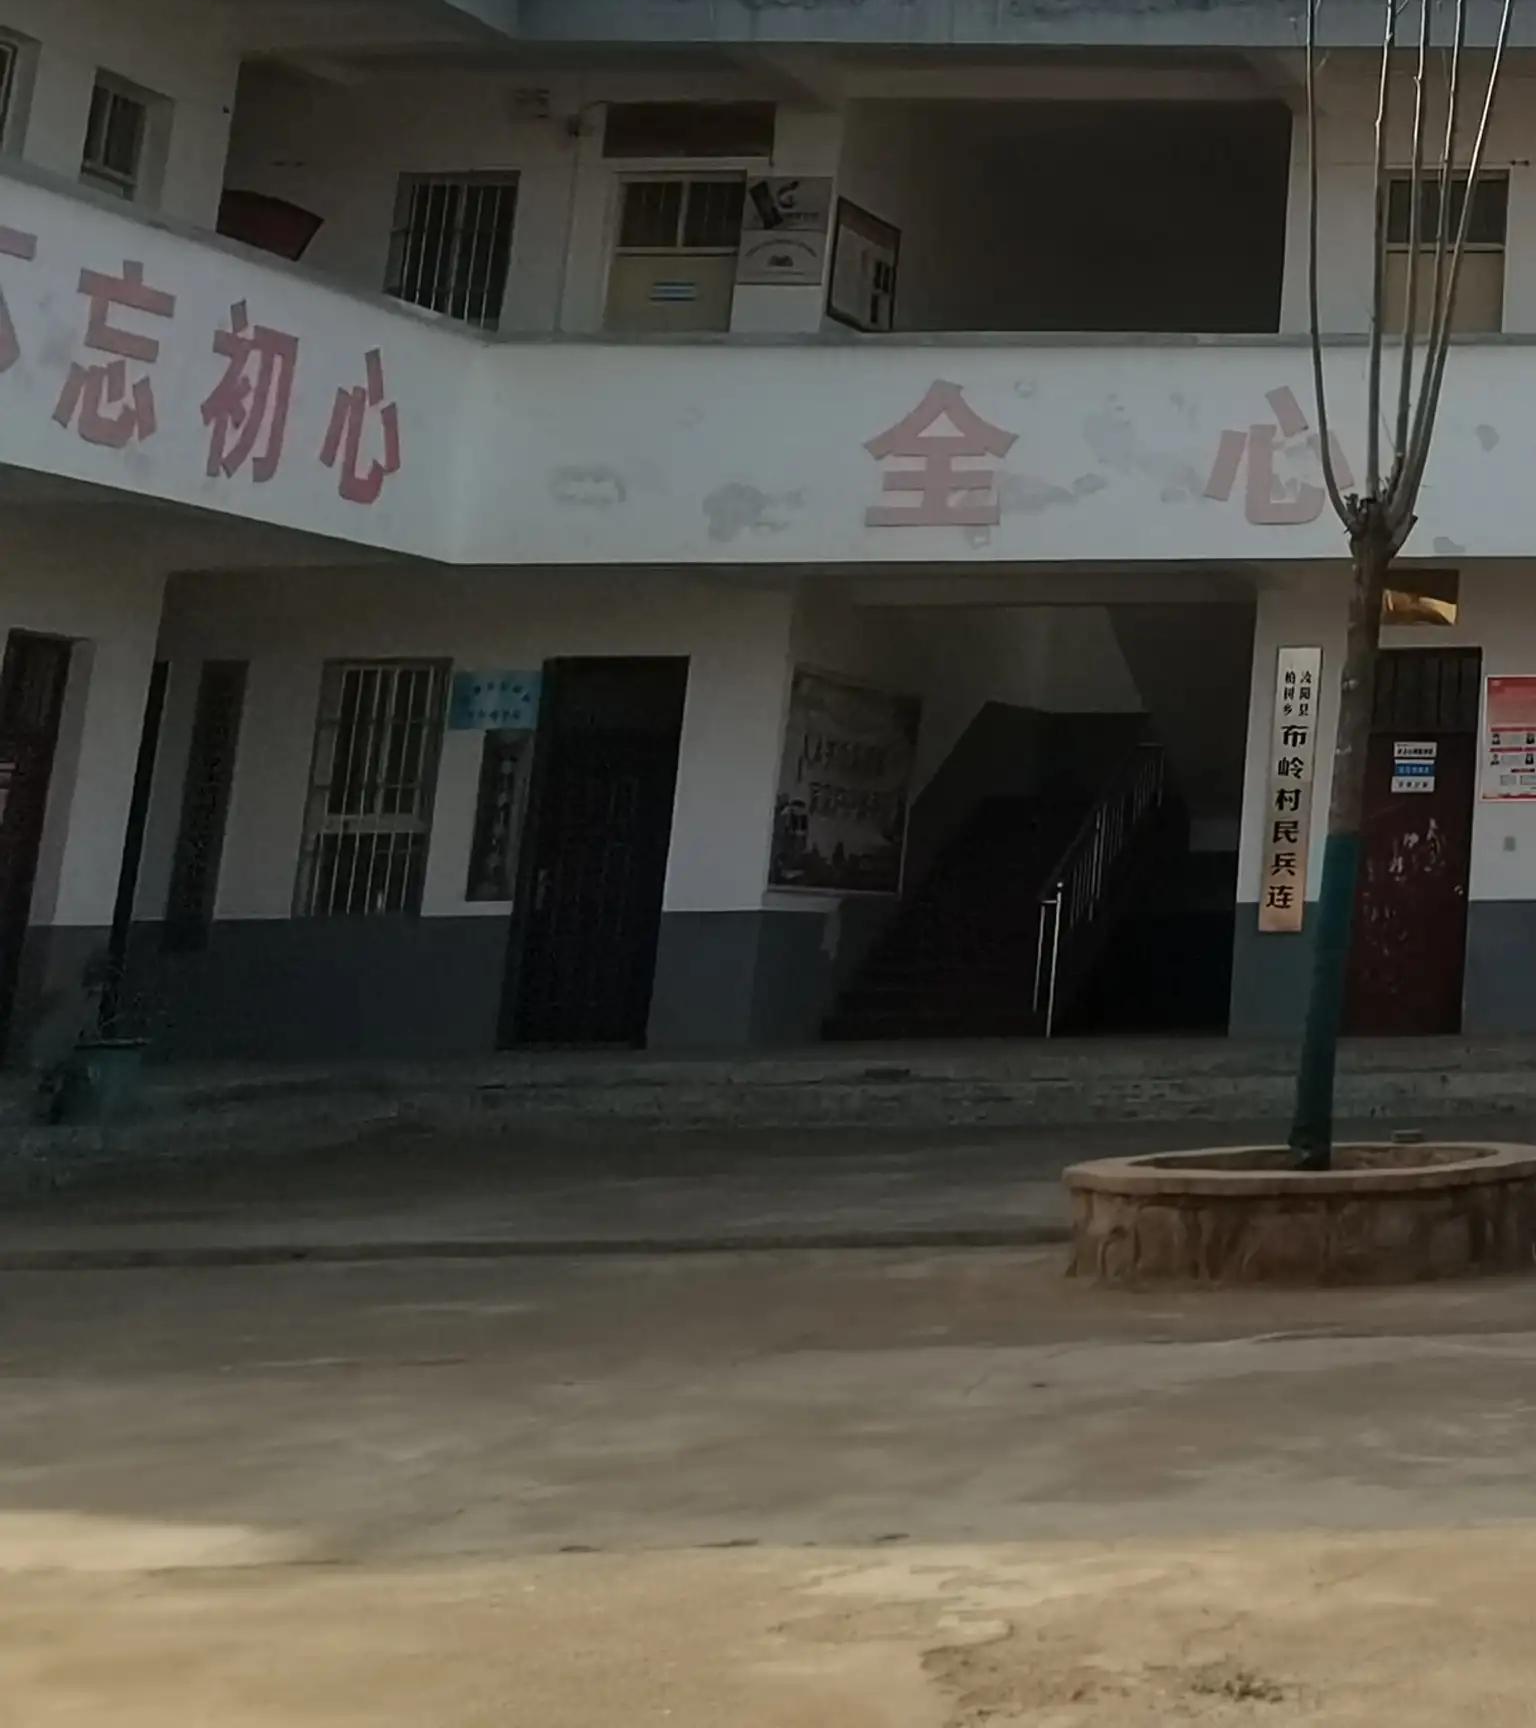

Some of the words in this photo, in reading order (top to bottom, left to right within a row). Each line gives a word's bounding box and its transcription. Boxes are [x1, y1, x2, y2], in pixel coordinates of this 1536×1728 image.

[0, 226, 400, 503] 忘初心
[1266, 724, 1308, 910] 布岭村民兵连
